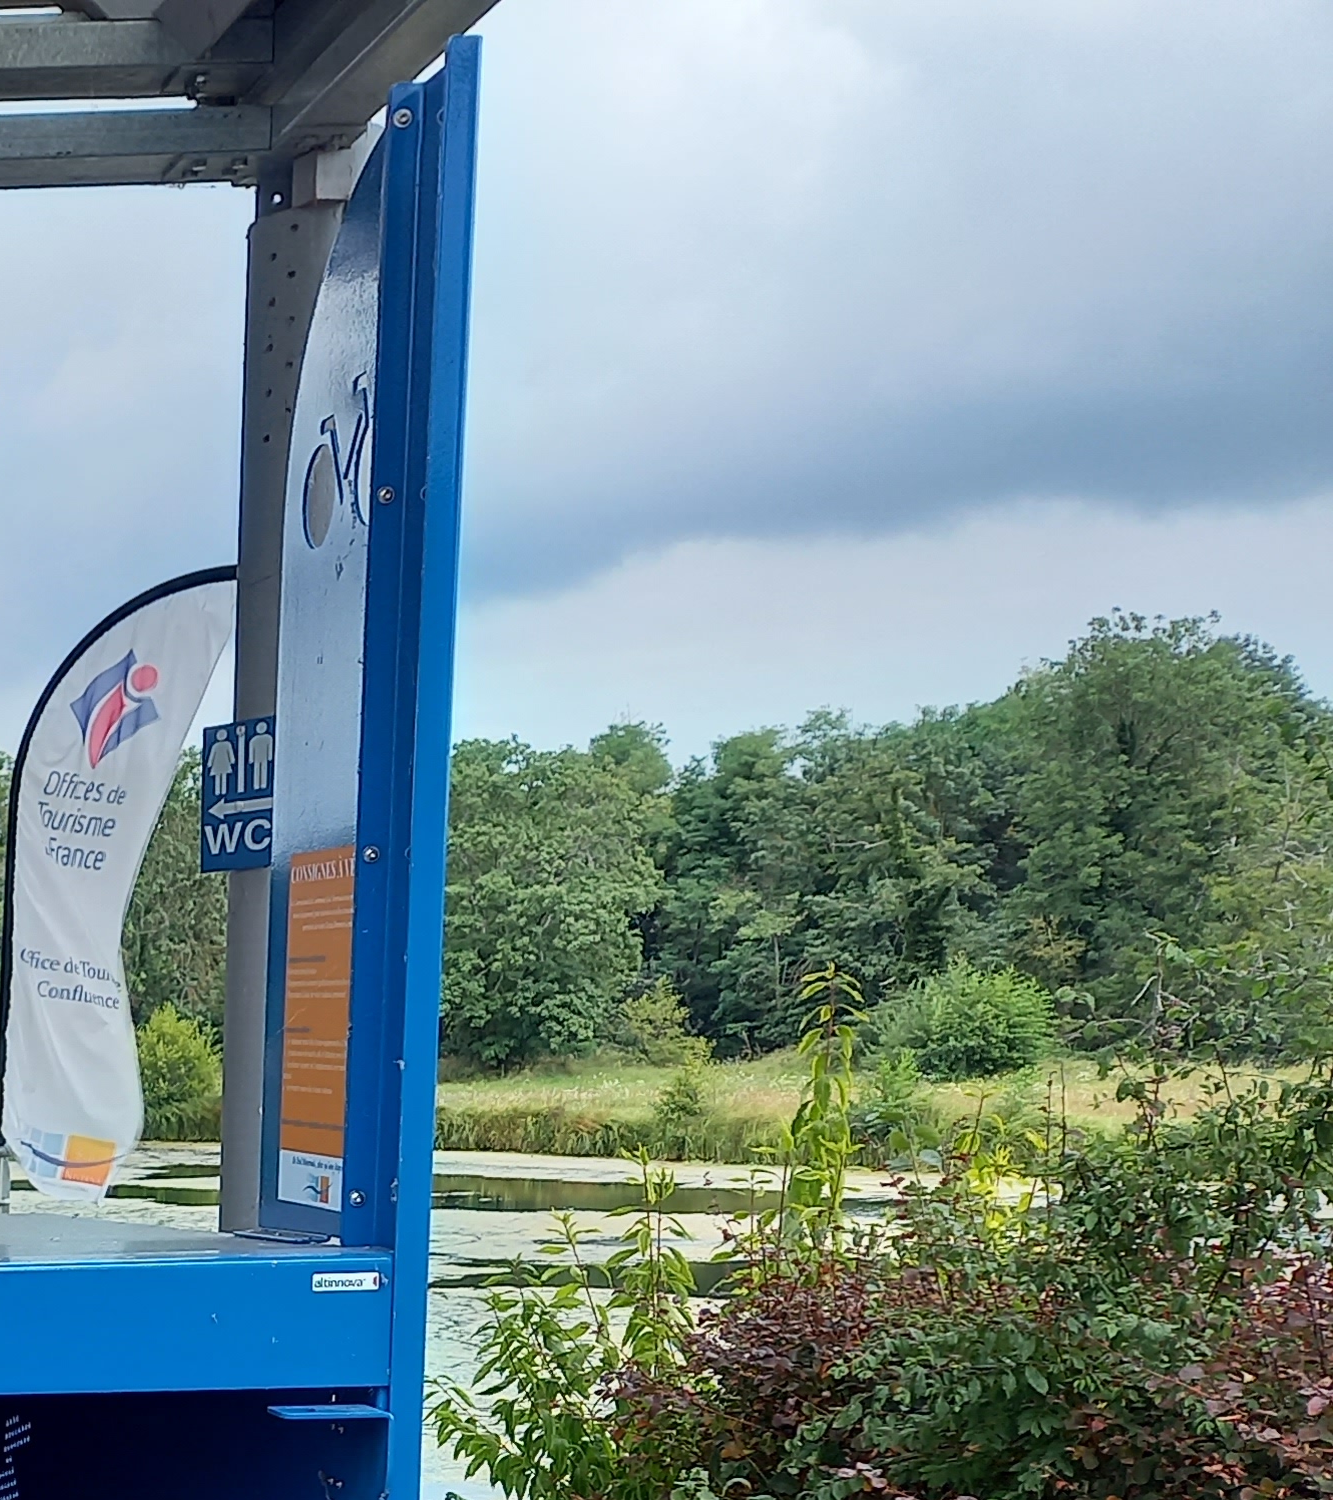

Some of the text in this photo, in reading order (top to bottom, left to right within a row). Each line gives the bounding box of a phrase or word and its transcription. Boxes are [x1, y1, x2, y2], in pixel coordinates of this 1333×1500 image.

[43, 771, 126, 805] Offices de
[38, 801, 116, 837] Tourisme
[46, 837, 107, 870] France
[204, 818, 271, 856] WC
[290, 860, 336, 884] CONSIGNES
[37, 980, 120, 1010] Confluence
